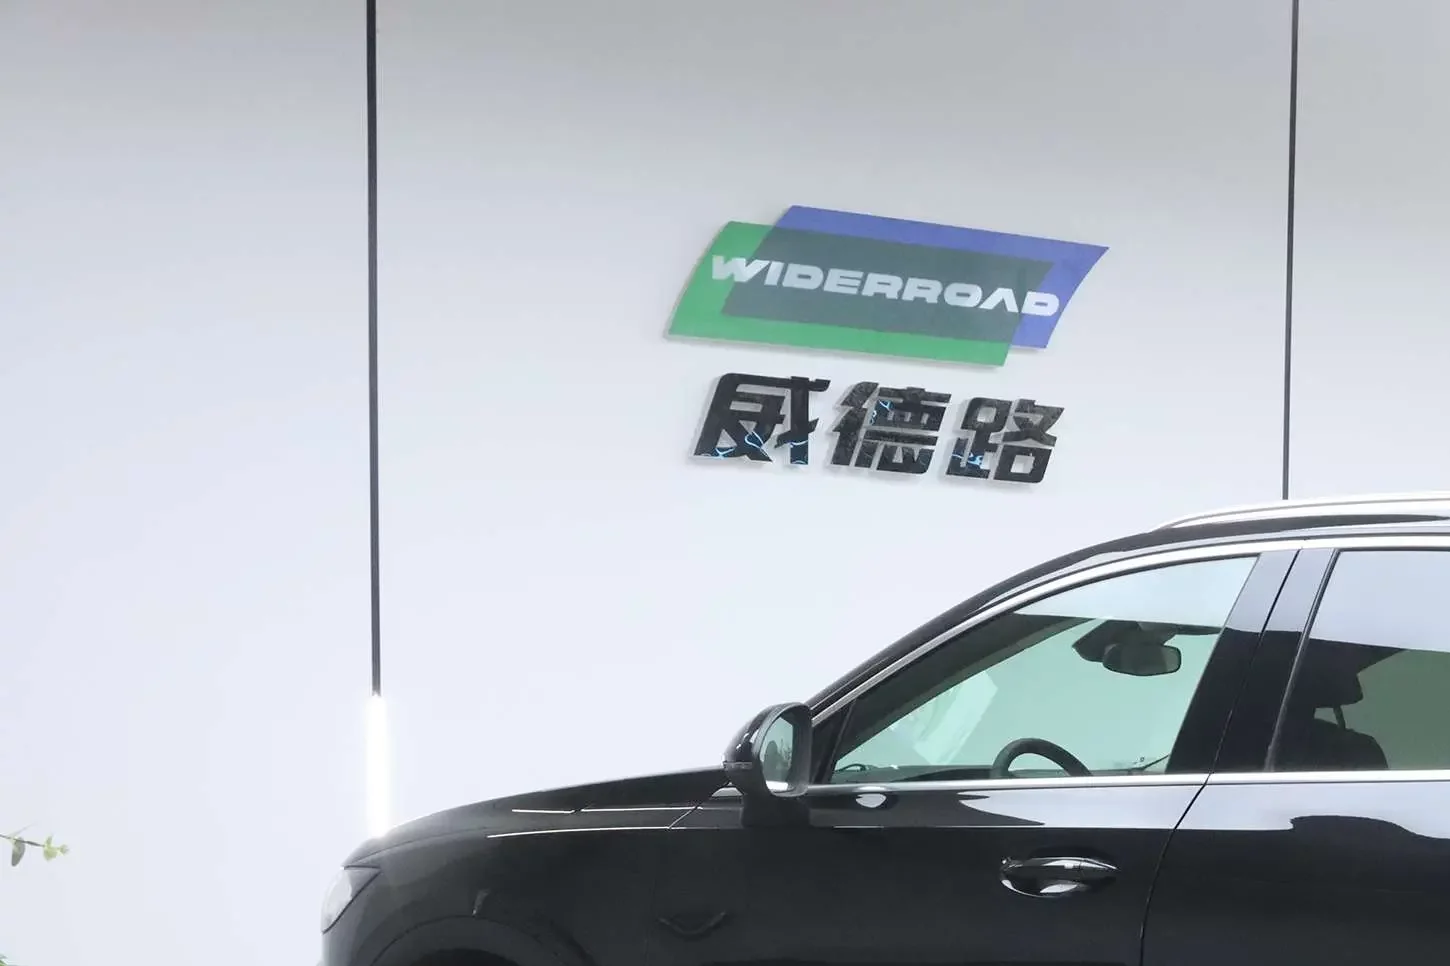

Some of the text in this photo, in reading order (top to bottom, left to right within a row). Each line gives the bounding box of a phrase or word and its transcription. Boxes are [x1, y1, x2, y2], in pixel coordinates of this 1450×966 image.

[711, 254, 1060, 318] WIDERROAD
[694, 372, 1065, 484] 威德路
